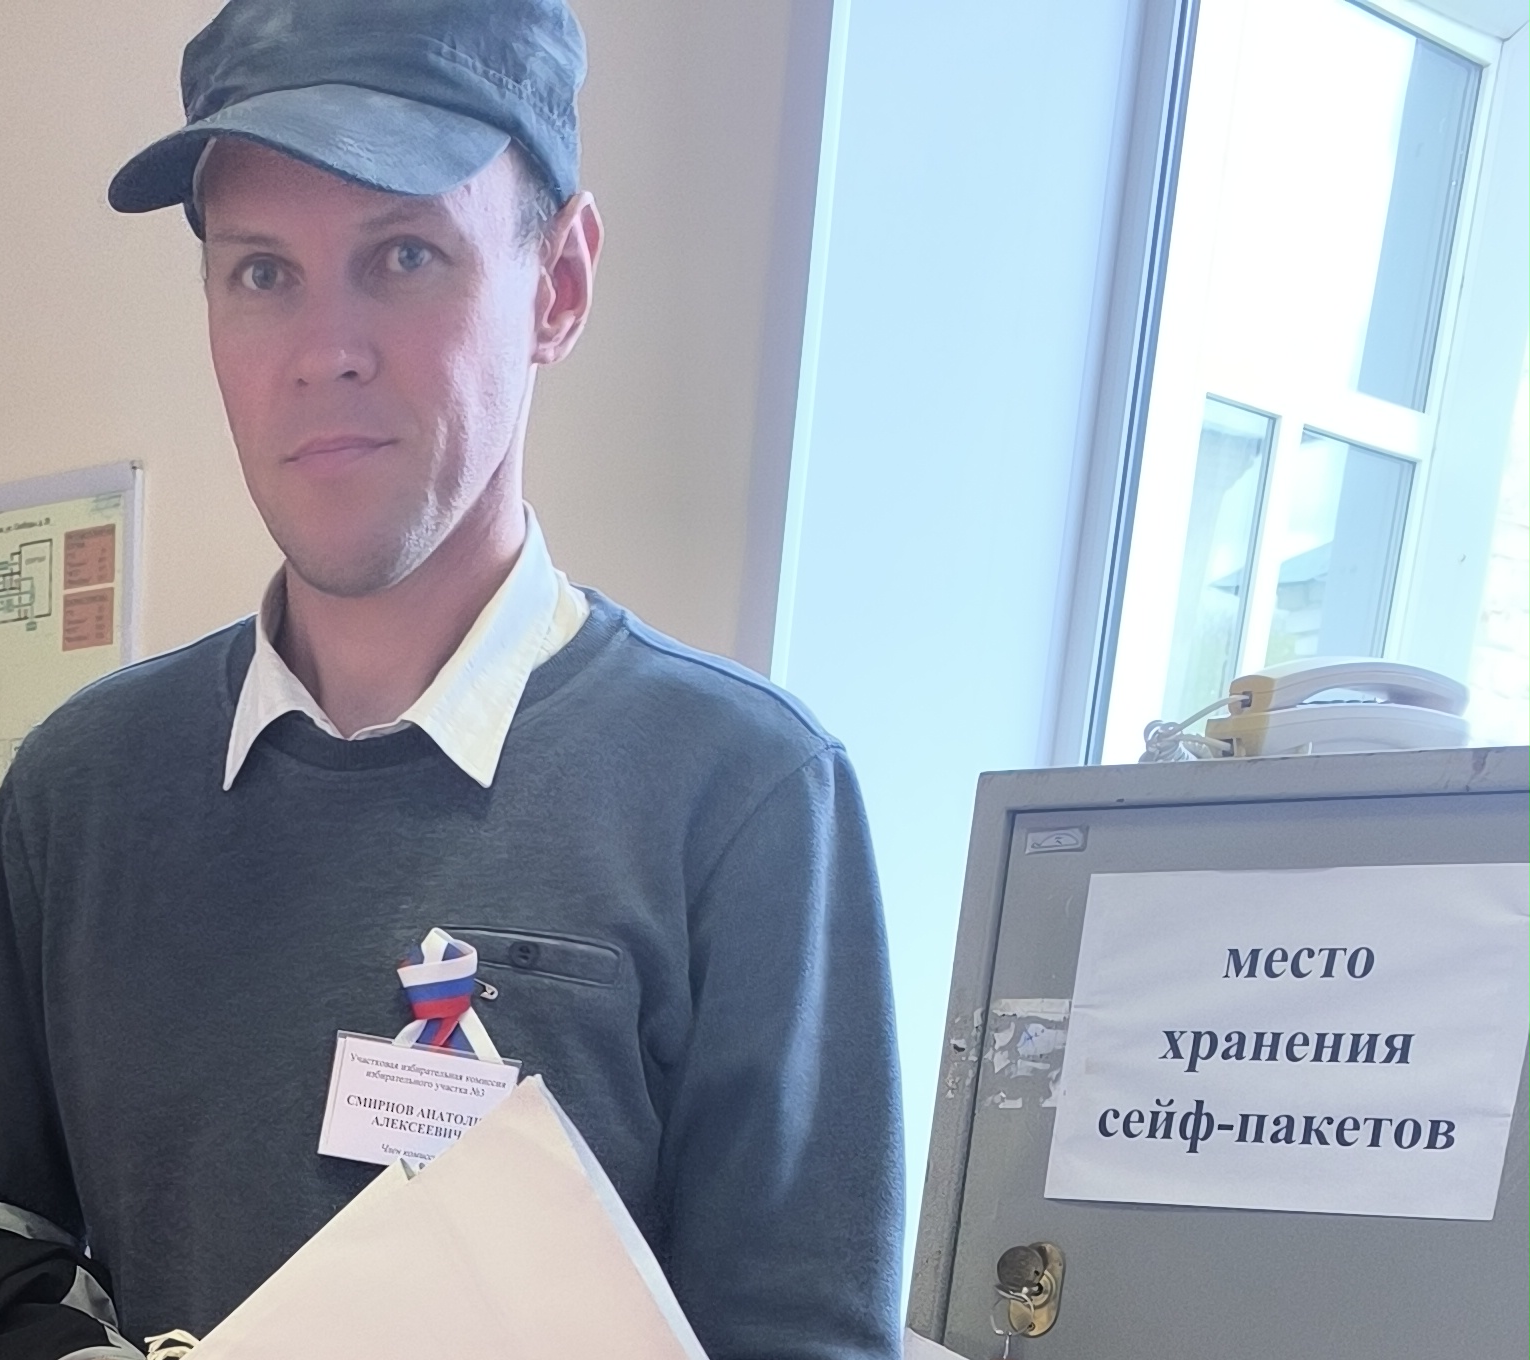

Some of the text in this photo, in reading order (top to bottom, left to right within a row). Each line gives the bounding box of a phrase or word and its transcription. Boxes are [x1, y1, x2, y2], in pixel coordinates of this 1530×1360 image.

[1222, 943, 1376, 980] место
[1158, 1026, 1415, 1073] хранения
[346, 1094, 414, 1116] СМИРНОВ
[371, 1115, 462, 1140] АЛЕКСЕЕВИЧ
[1097, 1097, 1456, 1154] сейф-пакетов
